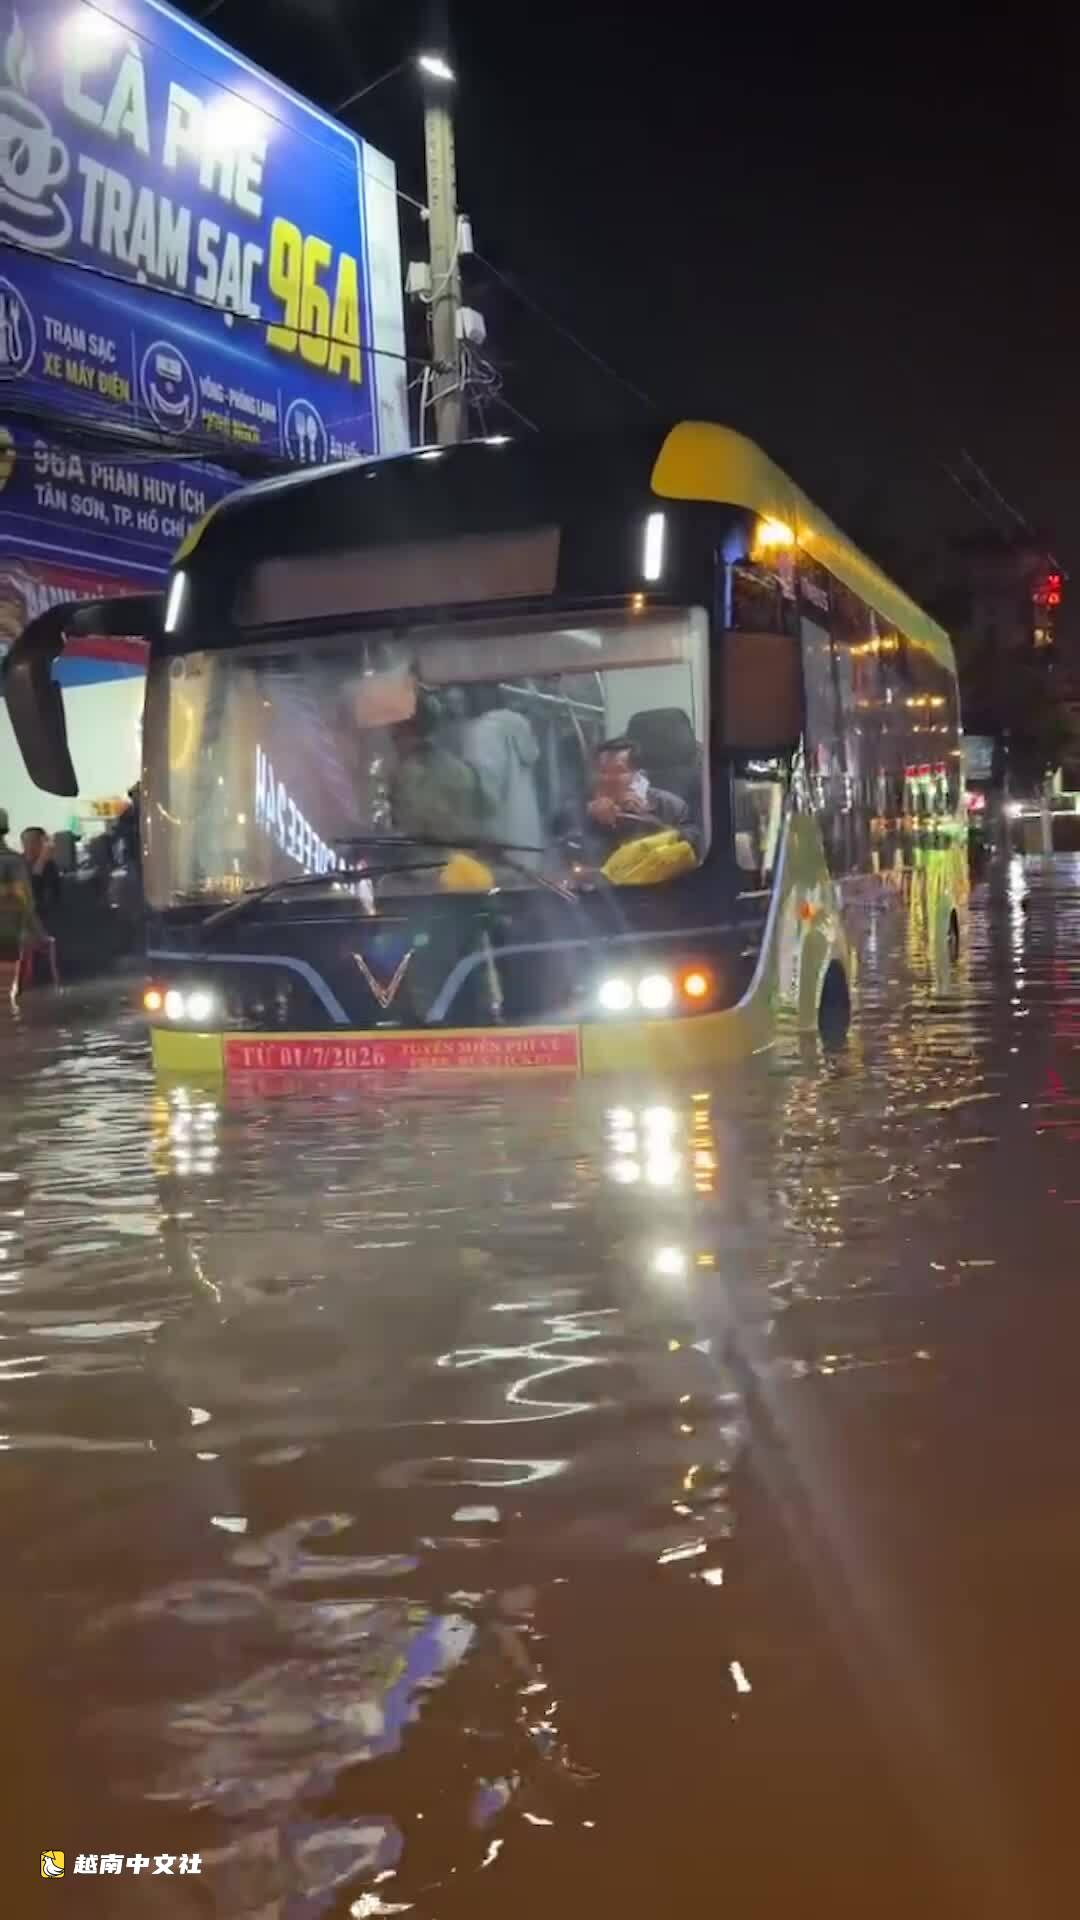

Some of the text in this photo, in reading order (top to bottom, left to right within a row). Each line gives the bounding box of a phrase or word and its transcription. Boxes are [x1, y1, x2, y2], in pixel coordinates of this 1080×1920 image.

[78, 153, 363, 385] TRẠM SẠC 96A
[43, 315, 86, 353] TRẠM
[34, 439, 85, 484] 96A
[90, 461, 138, 498] PHAN
[143, 475, 176, 508] HUY
[280, 1045, 385, 1067] 01/7/2026
